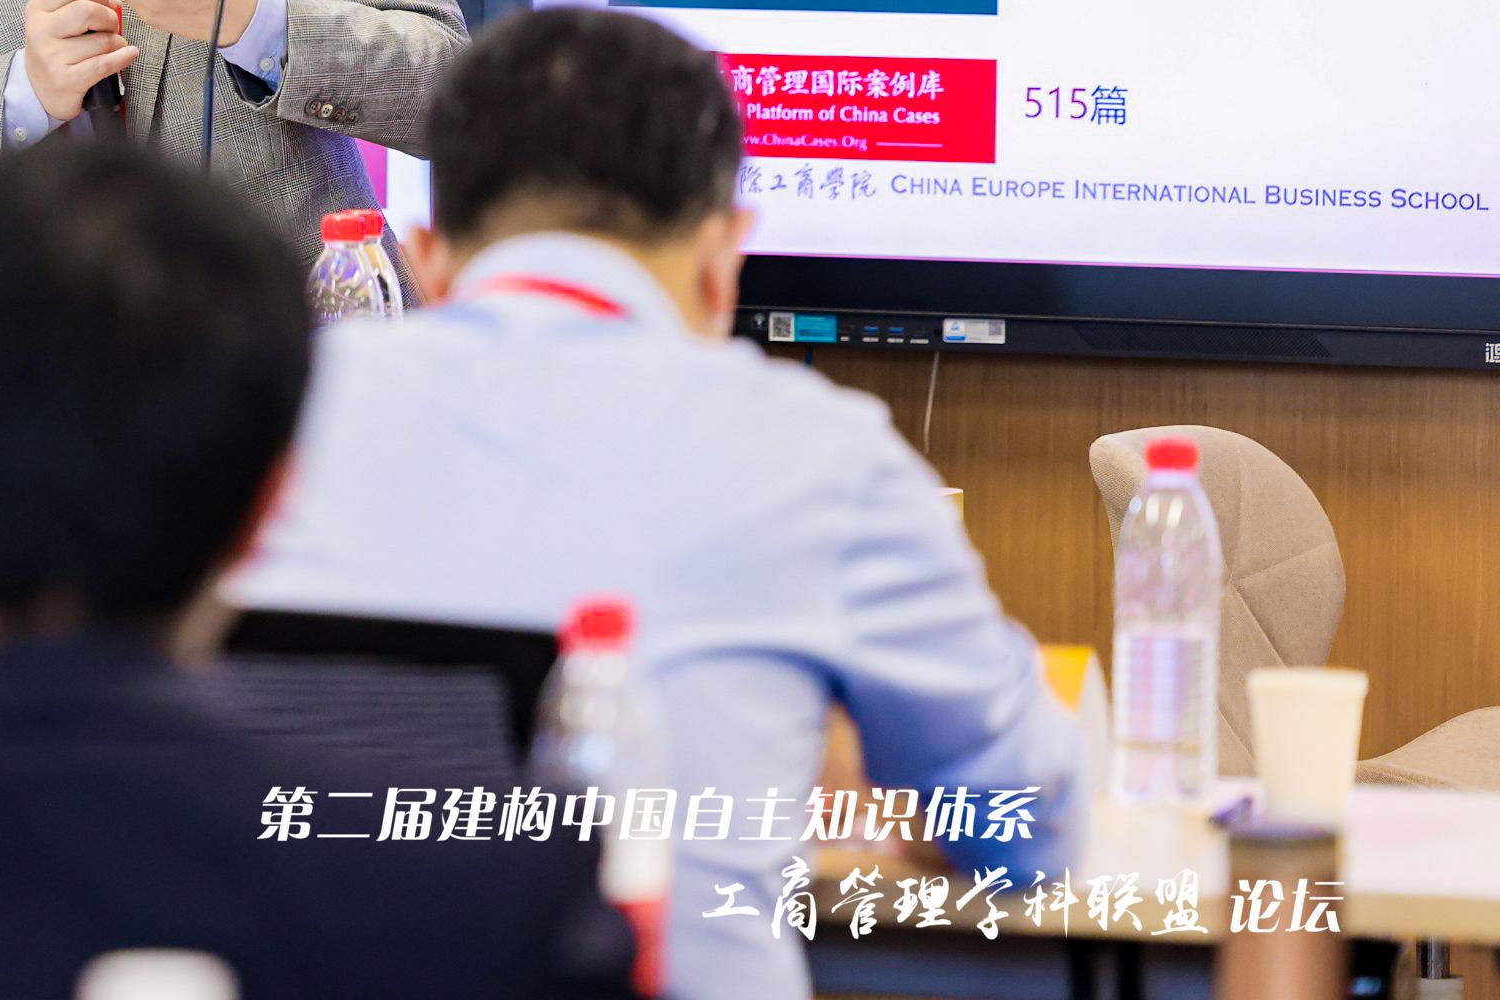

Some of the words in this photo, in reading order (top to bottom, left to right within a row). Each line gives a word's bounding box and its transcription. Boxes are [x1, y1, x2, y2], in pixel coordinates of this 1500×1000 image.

[730, 65, 945, 99] 商管理国际案例库
[746, 103, 813, 120] Platform
[818, 105, 836, 121] of
[840, 106, 888, 122] China
[893, 107, 940, 124] Cases
[1026, 86, 1128, 125] 515篇
